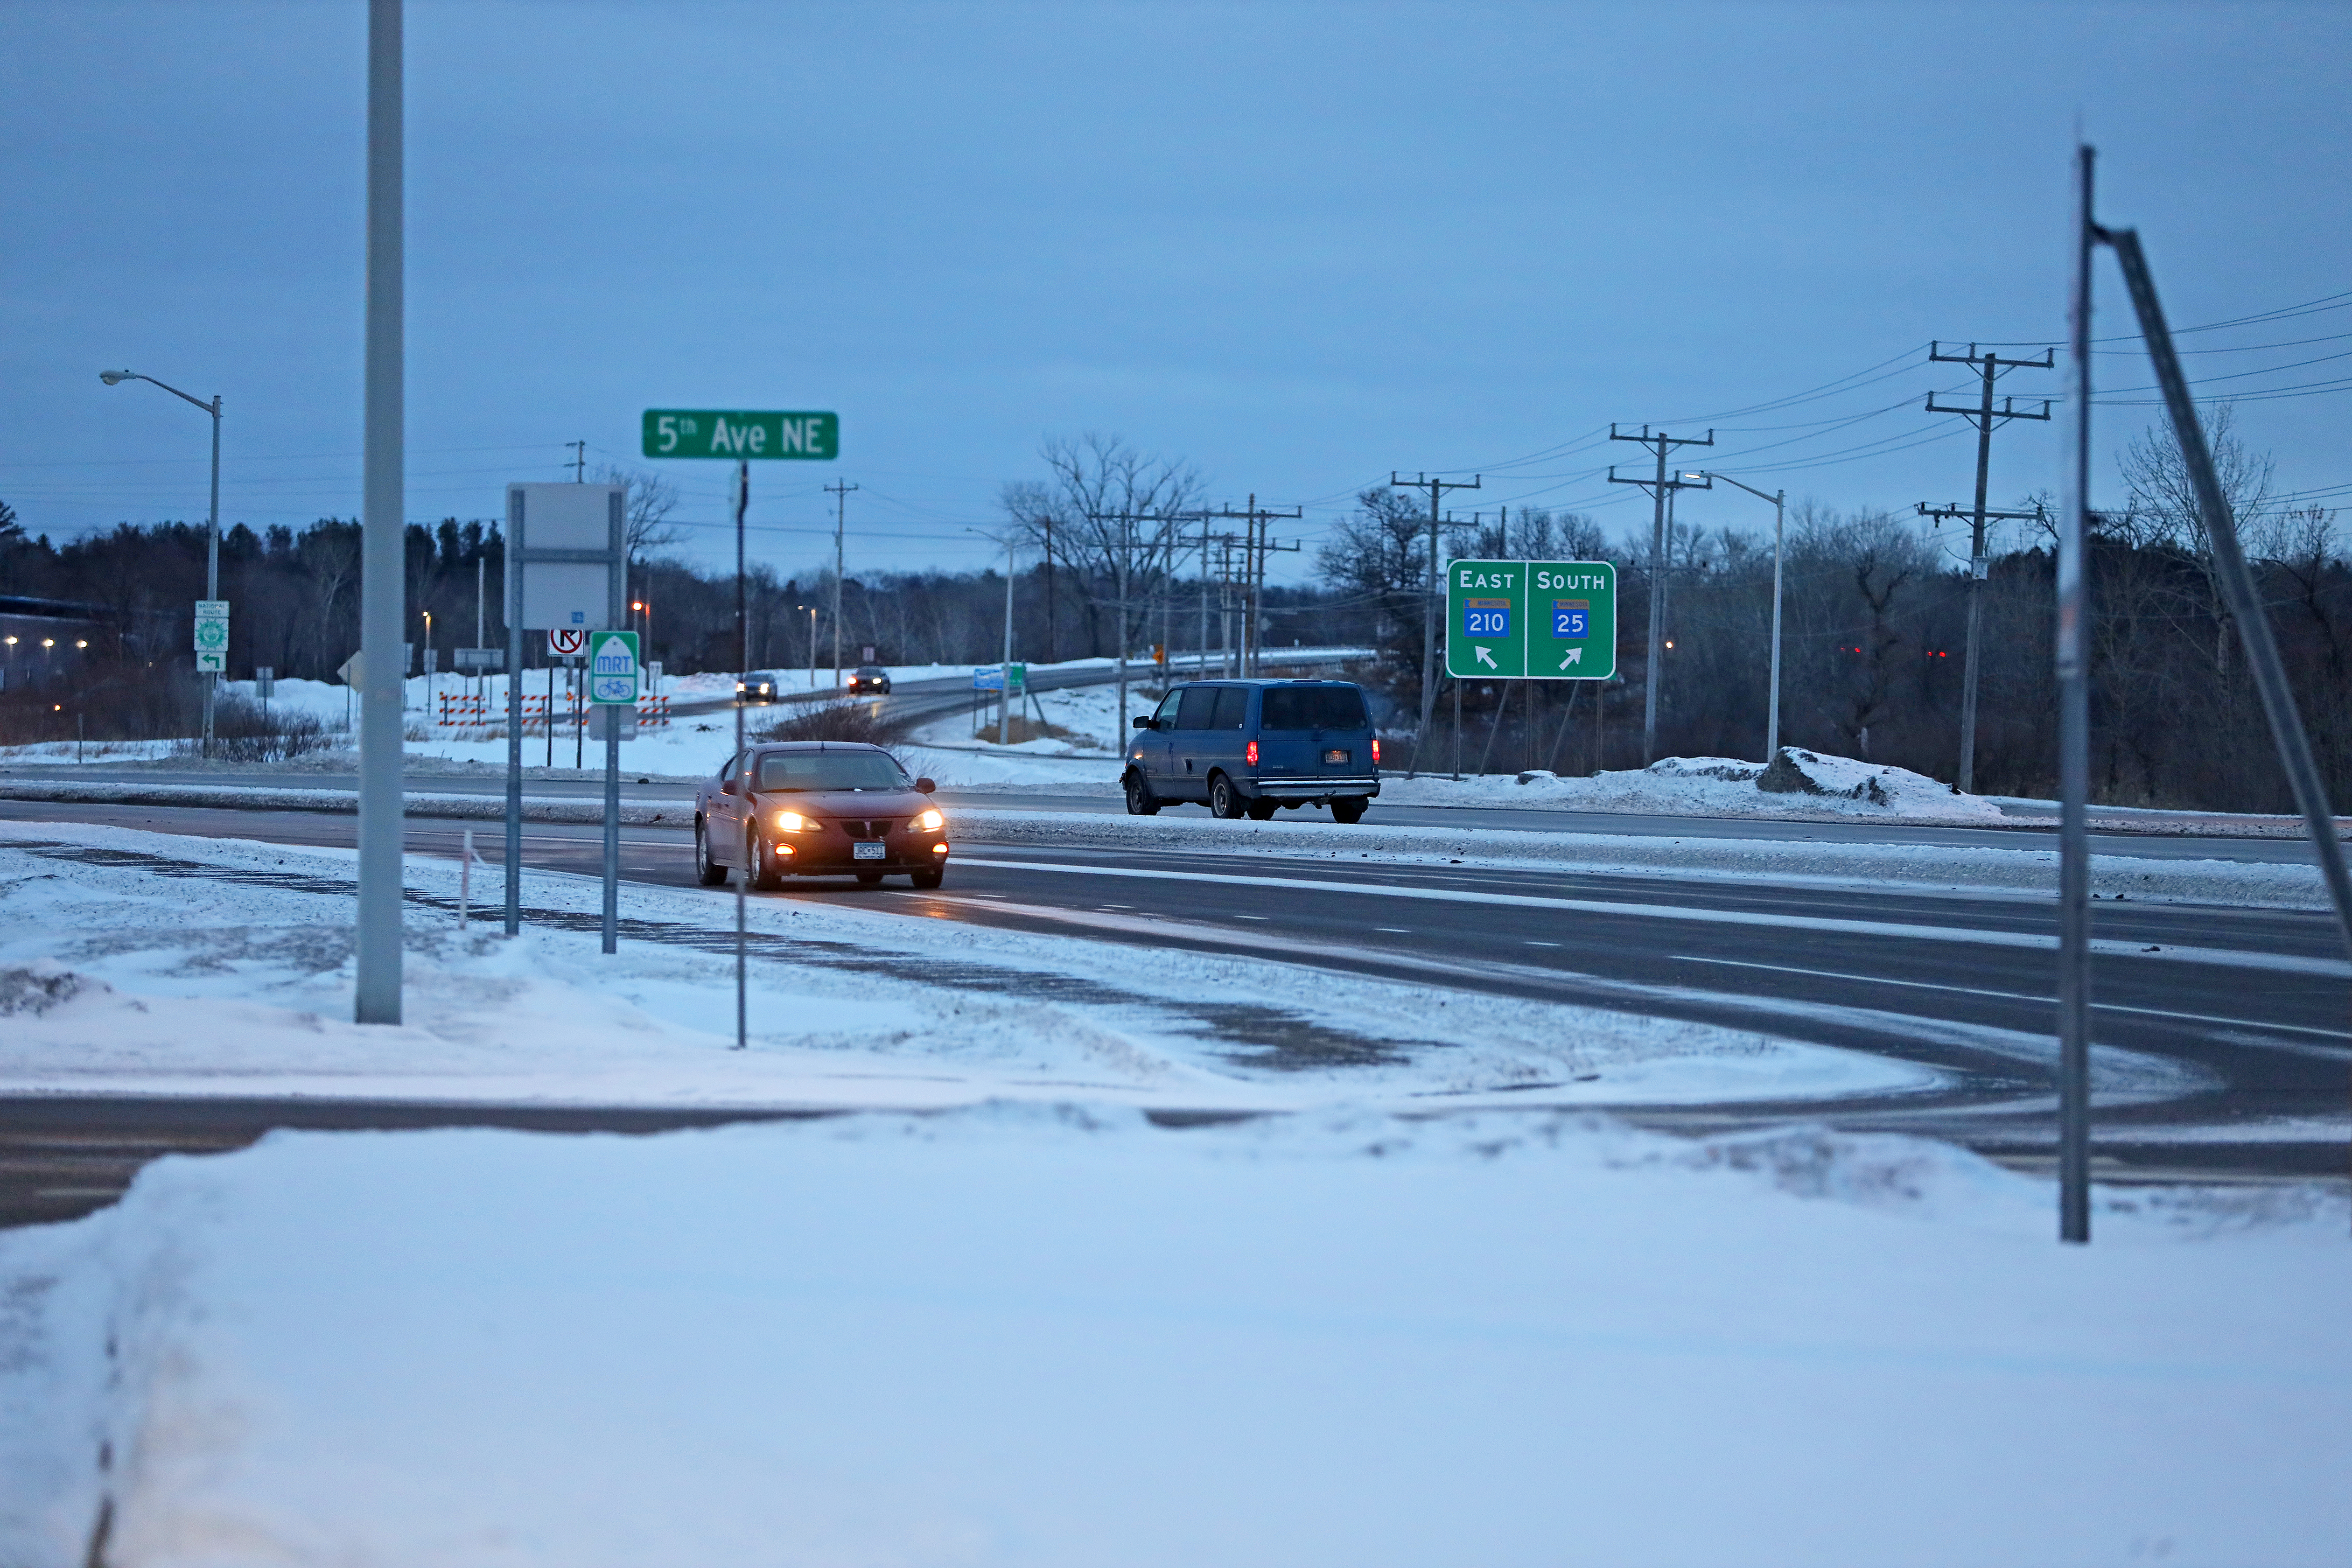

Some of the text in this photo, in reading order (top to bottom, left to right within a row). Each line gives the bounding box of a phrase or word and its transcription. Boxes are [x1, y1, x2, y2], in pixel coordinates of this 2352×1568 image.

[710, 417, 766, 453] Ave
[783, 419, 823, 453] NE
[1460, 570, 1514, 588] EAST
[1537, 571, 1605, 590] SOUTH
[1470, 613, 1504, 631] 210
[1557, 615, 1583, 633] 25
[596, 656, 630, 672] MRT
